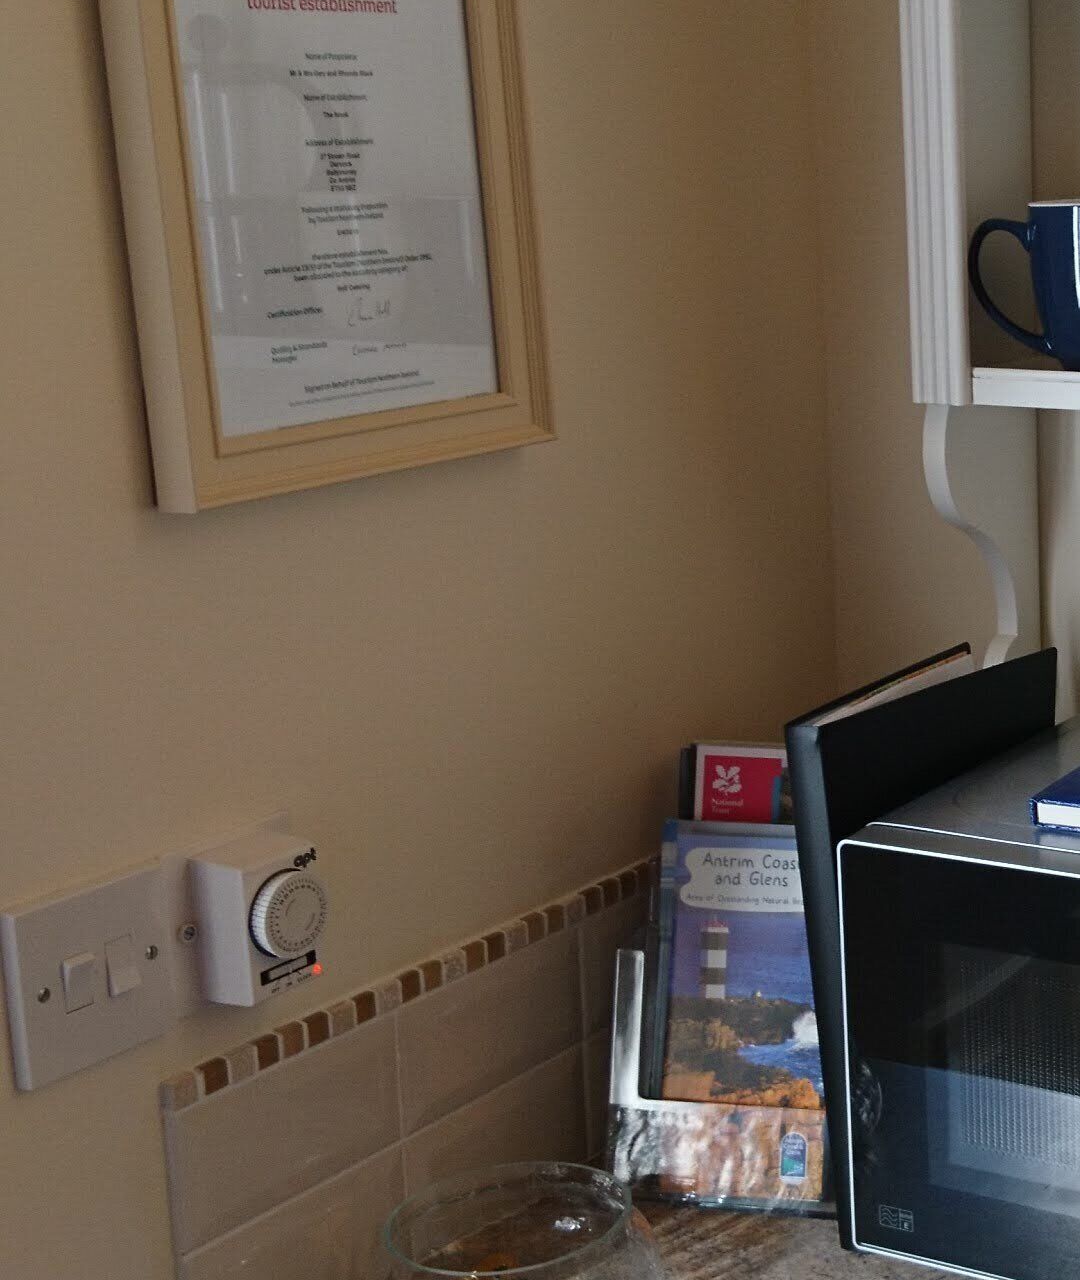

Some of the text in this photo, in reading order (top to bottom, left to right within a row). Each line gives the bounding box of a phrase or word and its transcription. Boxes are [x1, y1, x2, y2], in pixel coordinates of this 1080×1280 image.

[711, 797, 745, 807] National
[702, 852, 755, 869] Antrim
[714, 871, 790, 888] and Glens
